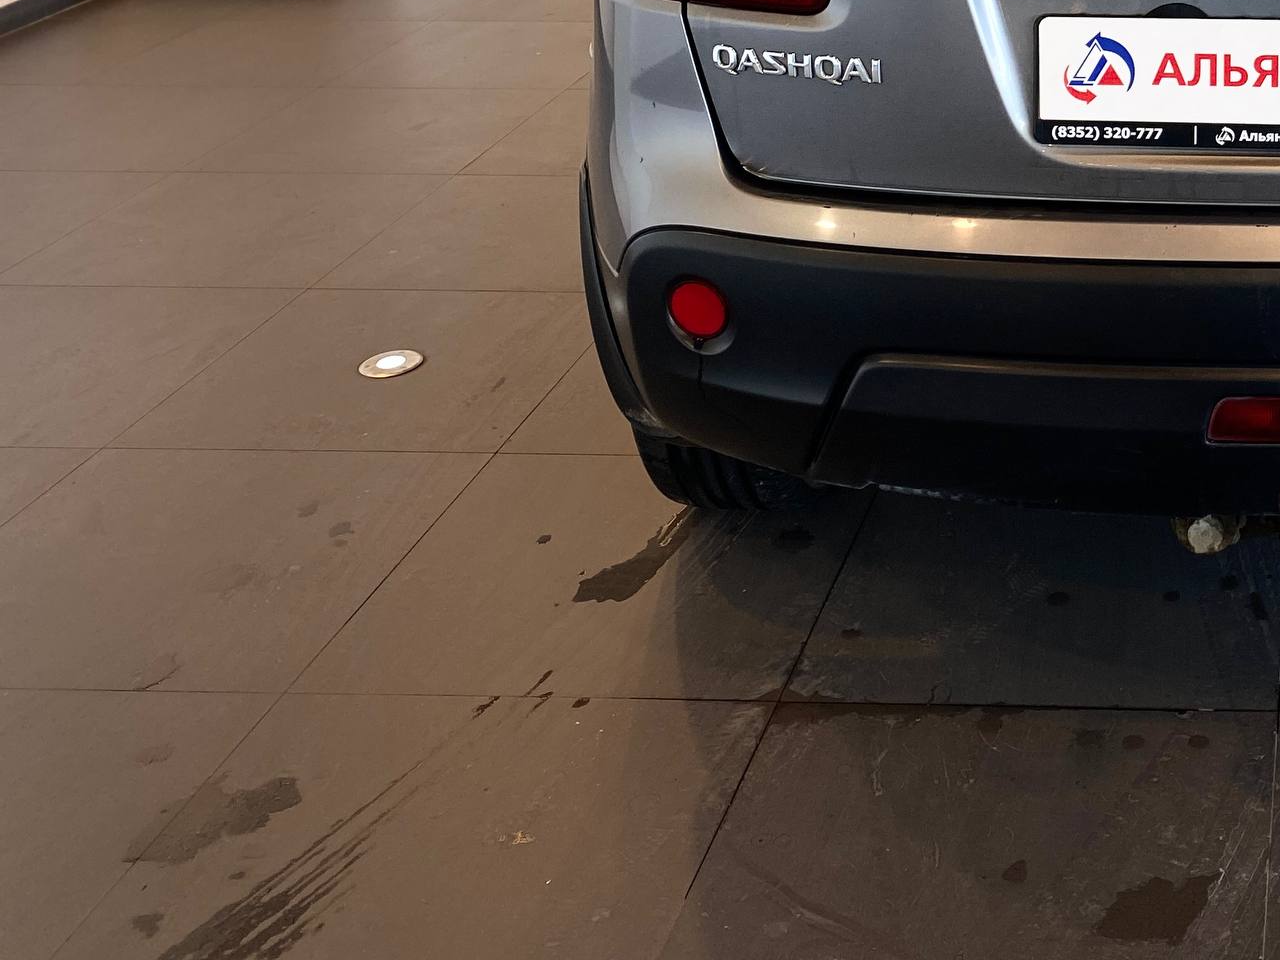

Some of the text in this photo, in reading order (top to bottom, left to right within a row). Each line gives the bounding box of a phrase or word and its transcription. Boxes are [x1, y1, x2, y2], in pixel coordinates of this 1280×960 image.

[712, 43, 883, 86] QASHQAI
[1051, 125, 1164, 141] (8352) 320-777
